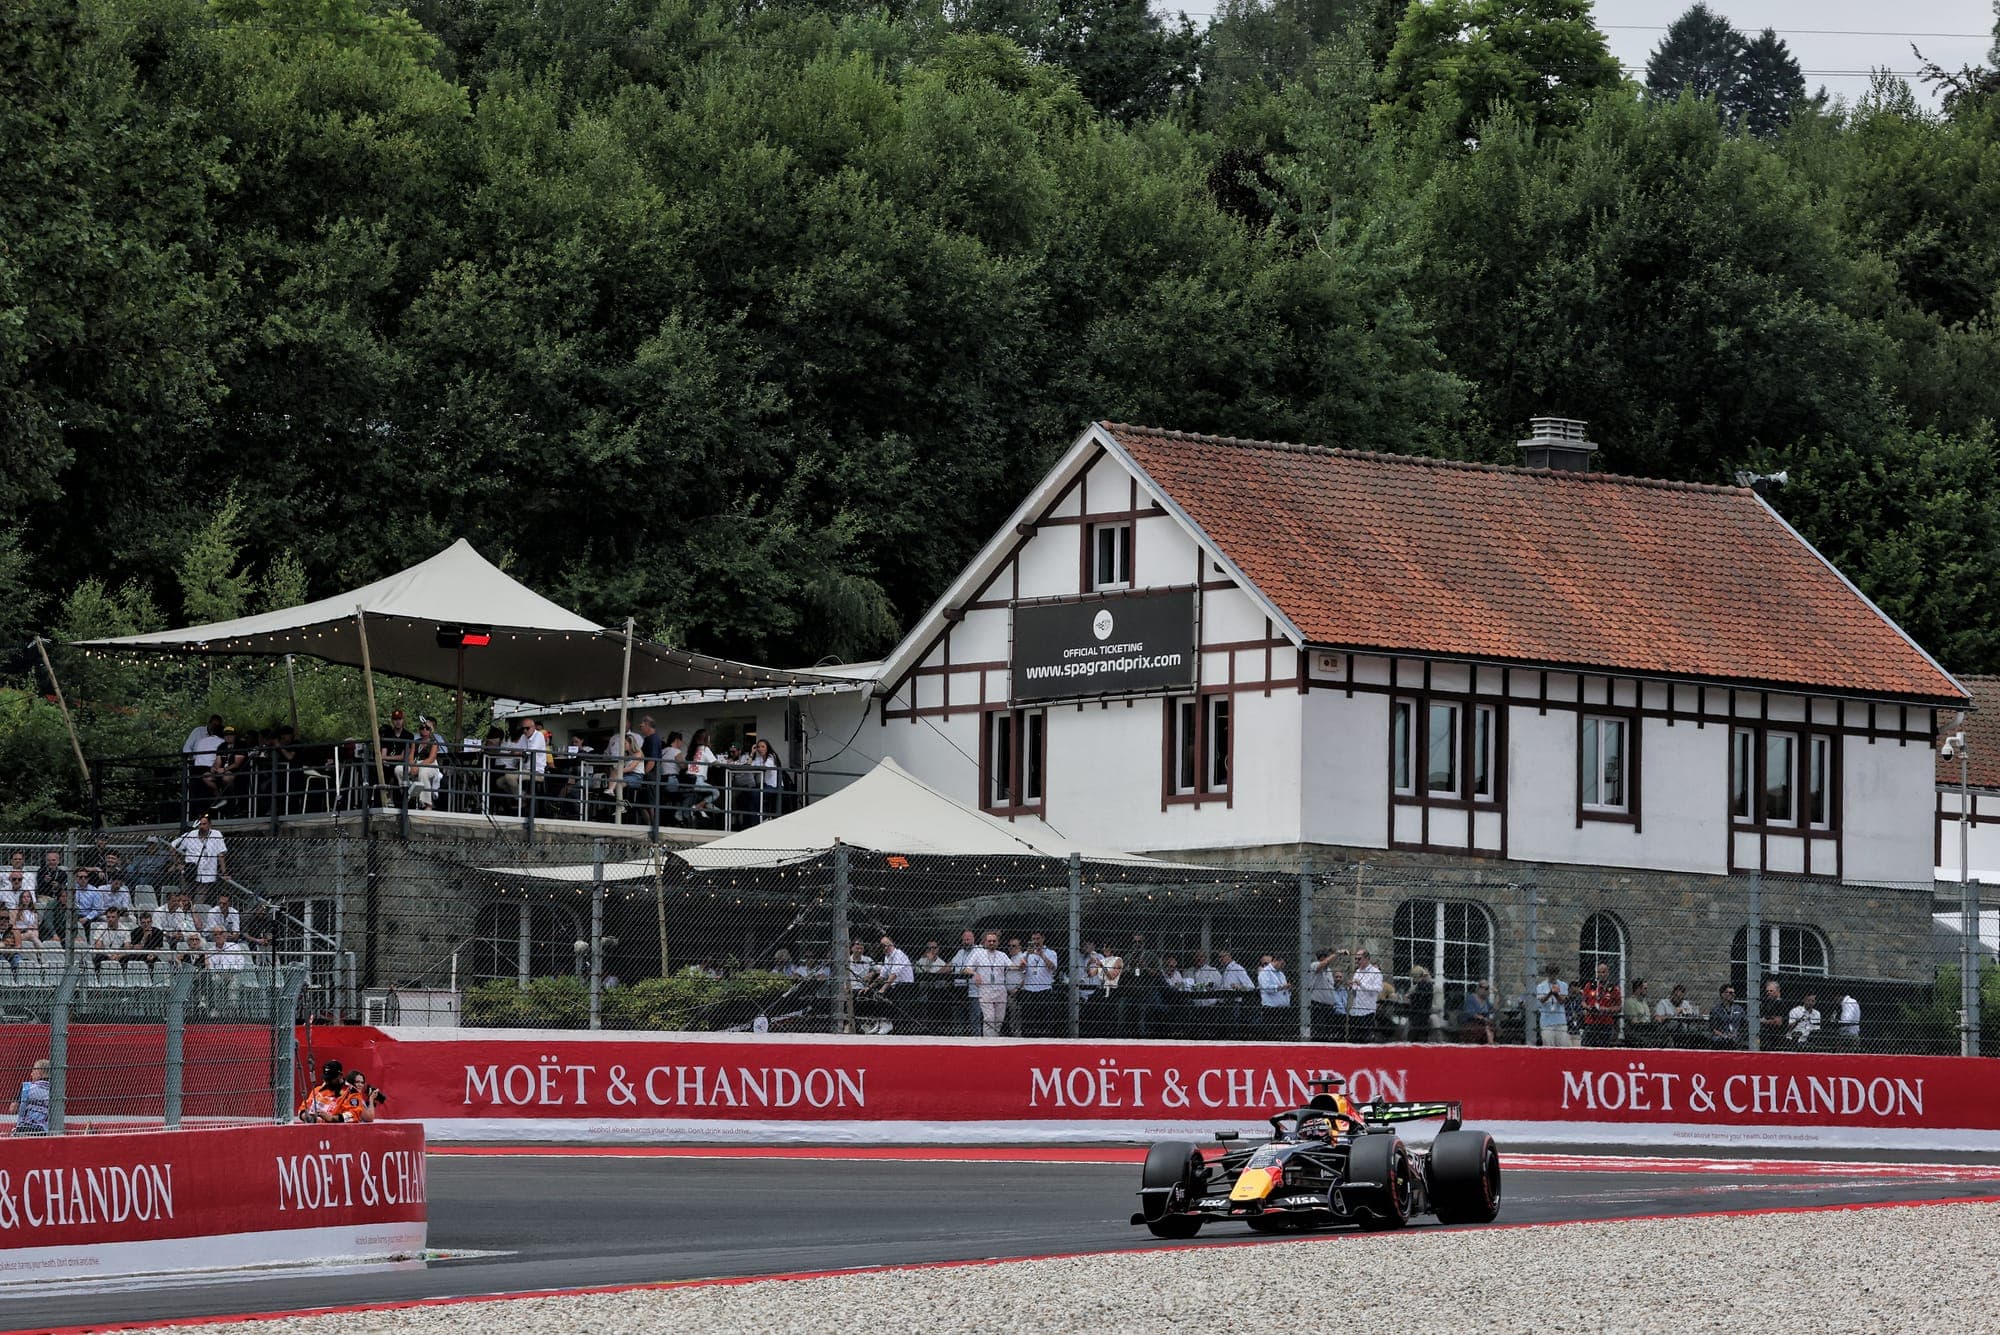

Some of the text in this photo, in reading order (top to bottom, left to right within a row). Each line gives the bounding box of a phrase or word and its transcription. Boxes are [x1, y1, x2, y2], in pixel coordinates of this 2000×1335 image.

[1026, 652, 1182, 680] www.spagrandprix.com
[1063, 642, 1143, 659] OFFICIAL TICKETING
[463, 1054, 867, 1108] MOËT & CHANDON
[1029, 1058, 1152, 1107] MOËT
[1161, 1068, 1190, 1108] &
[1561, 1062, 1925, 1116] MOËT & CHANDON
[0, 1164, 174, 1229] & CHANDON
[276, 1140, 354, 1211] MOËT
[360, 1151, 379, 1206] &
[1285, 1196, 1321, 1205] VISA
